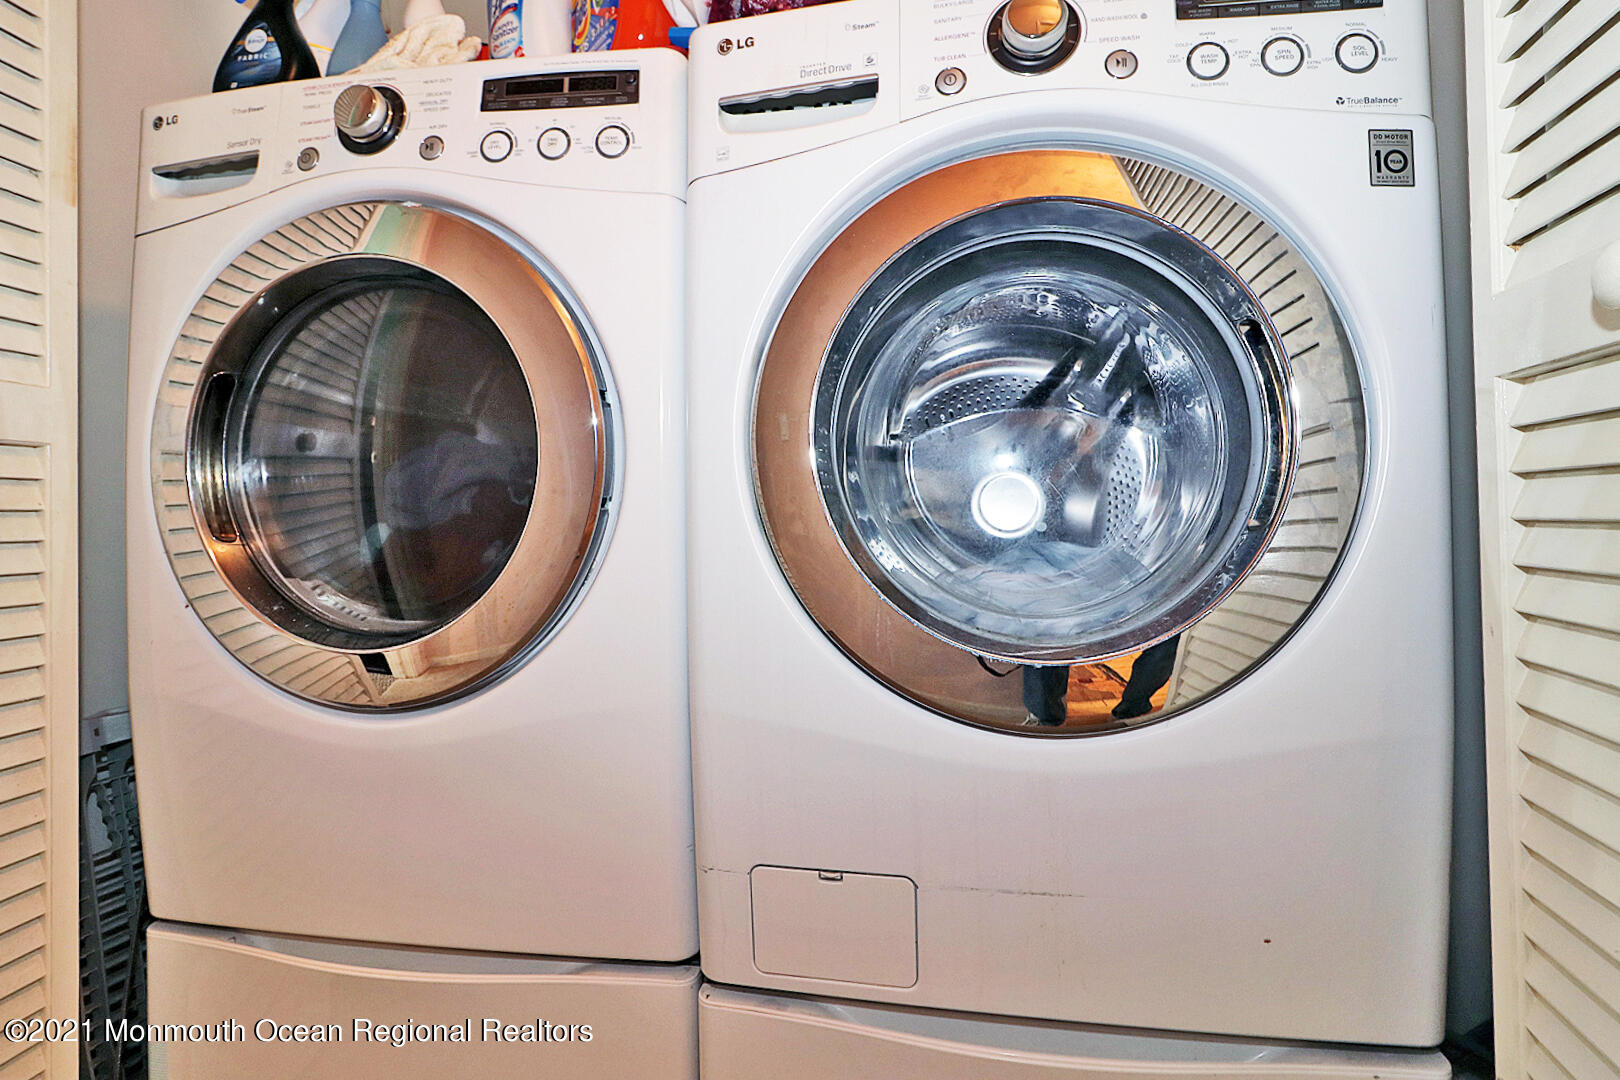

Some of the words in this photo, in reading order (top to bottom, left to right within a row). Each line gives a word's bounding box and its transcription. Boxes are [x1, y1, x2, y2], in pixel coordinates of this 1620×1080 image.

[736, 36, 755, 49] LG
[236, 53, 269, 62] FABRIC
[165, 114, 179, 126] LG
[1373, 133, 1383, 141] DD
[1384, 133, 1409, 141] MOTOR
[1374, 149, 1409, 174] 10
